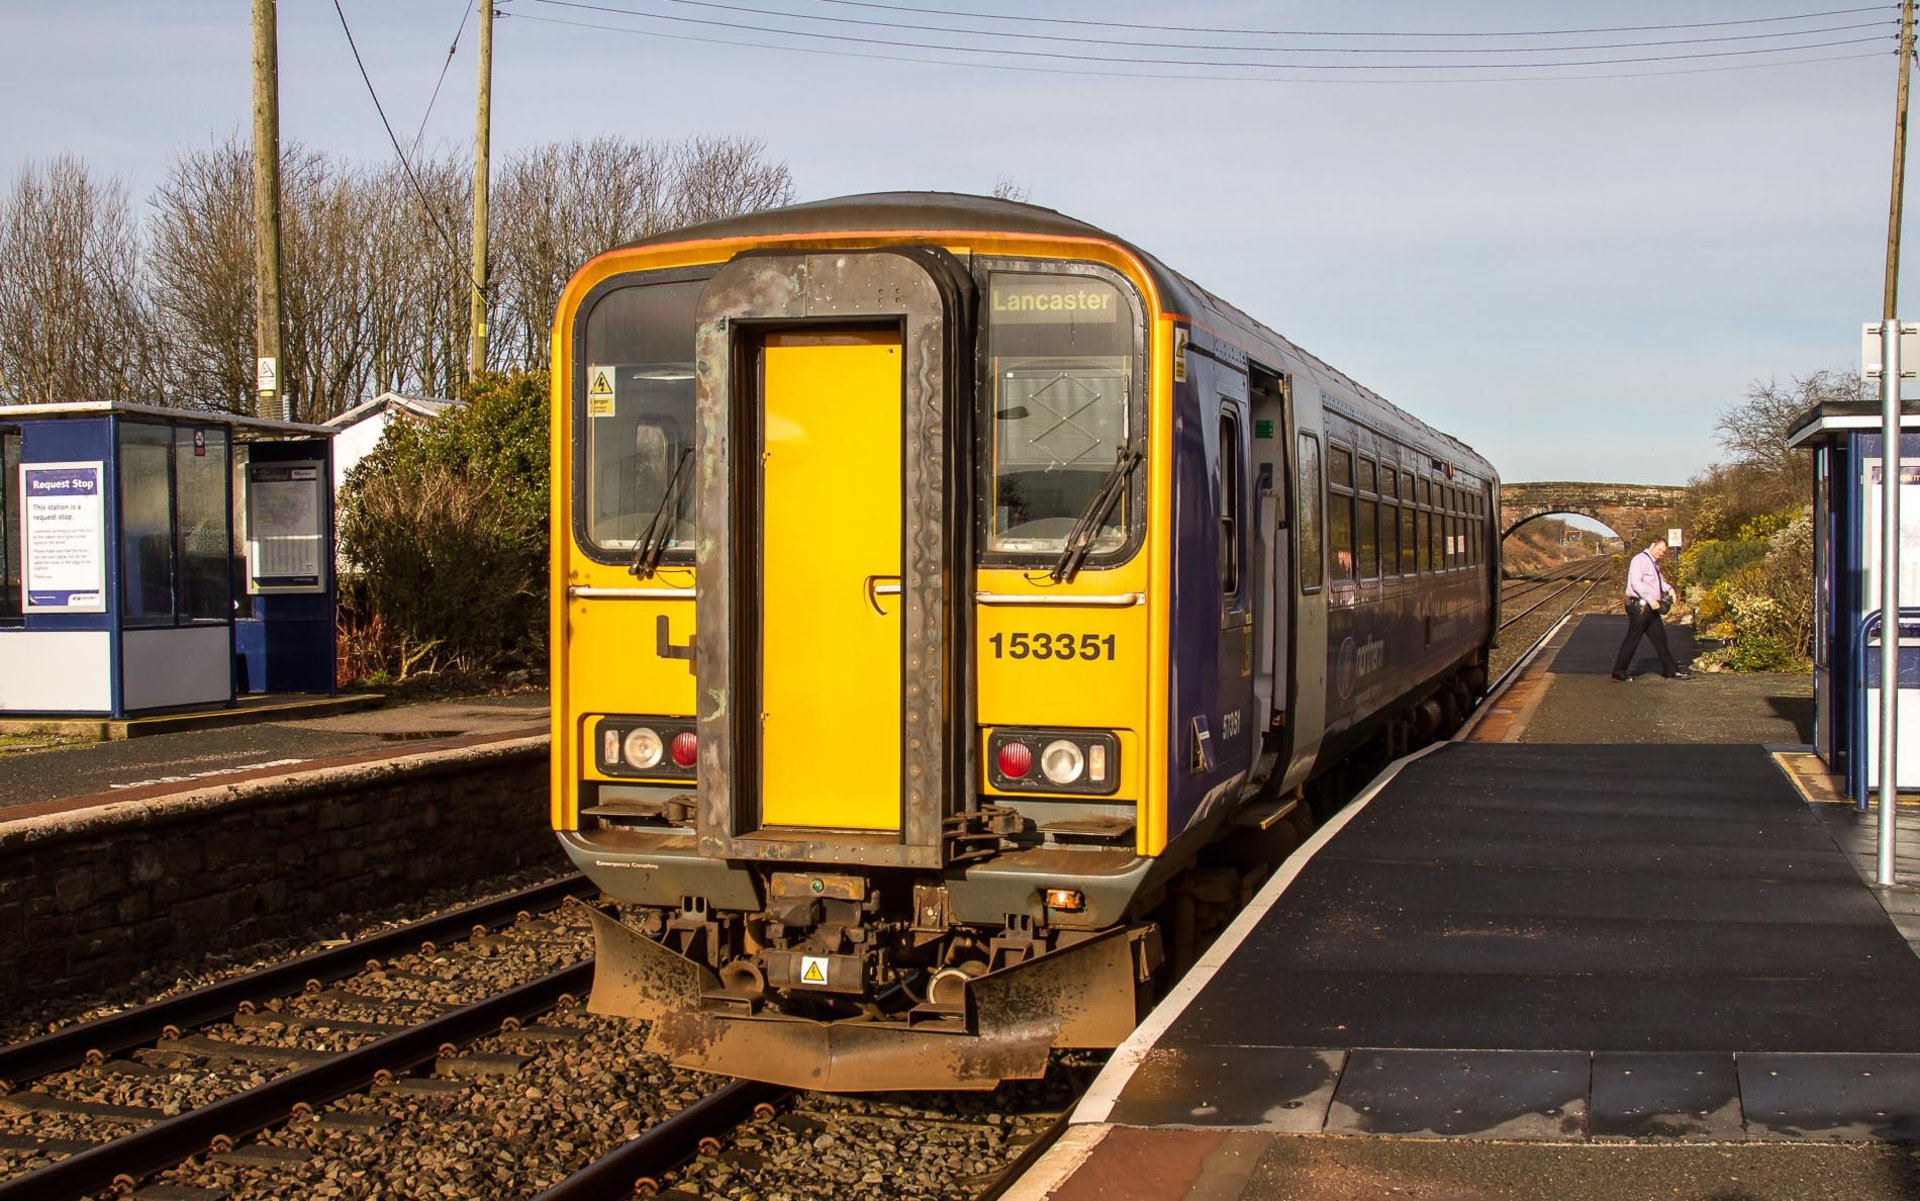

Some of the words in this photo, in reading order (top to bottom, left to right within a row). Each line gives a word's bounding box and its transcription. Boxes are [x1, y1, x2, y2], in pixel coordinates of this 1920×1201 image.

[993, 289, 1111, 311] Lancaster
[33, 480, 70, 491] Request
[72, 479, 94, 490] Stop
[33, 514, 57, 522] request
[989, 632, 1115, 661] 153351
